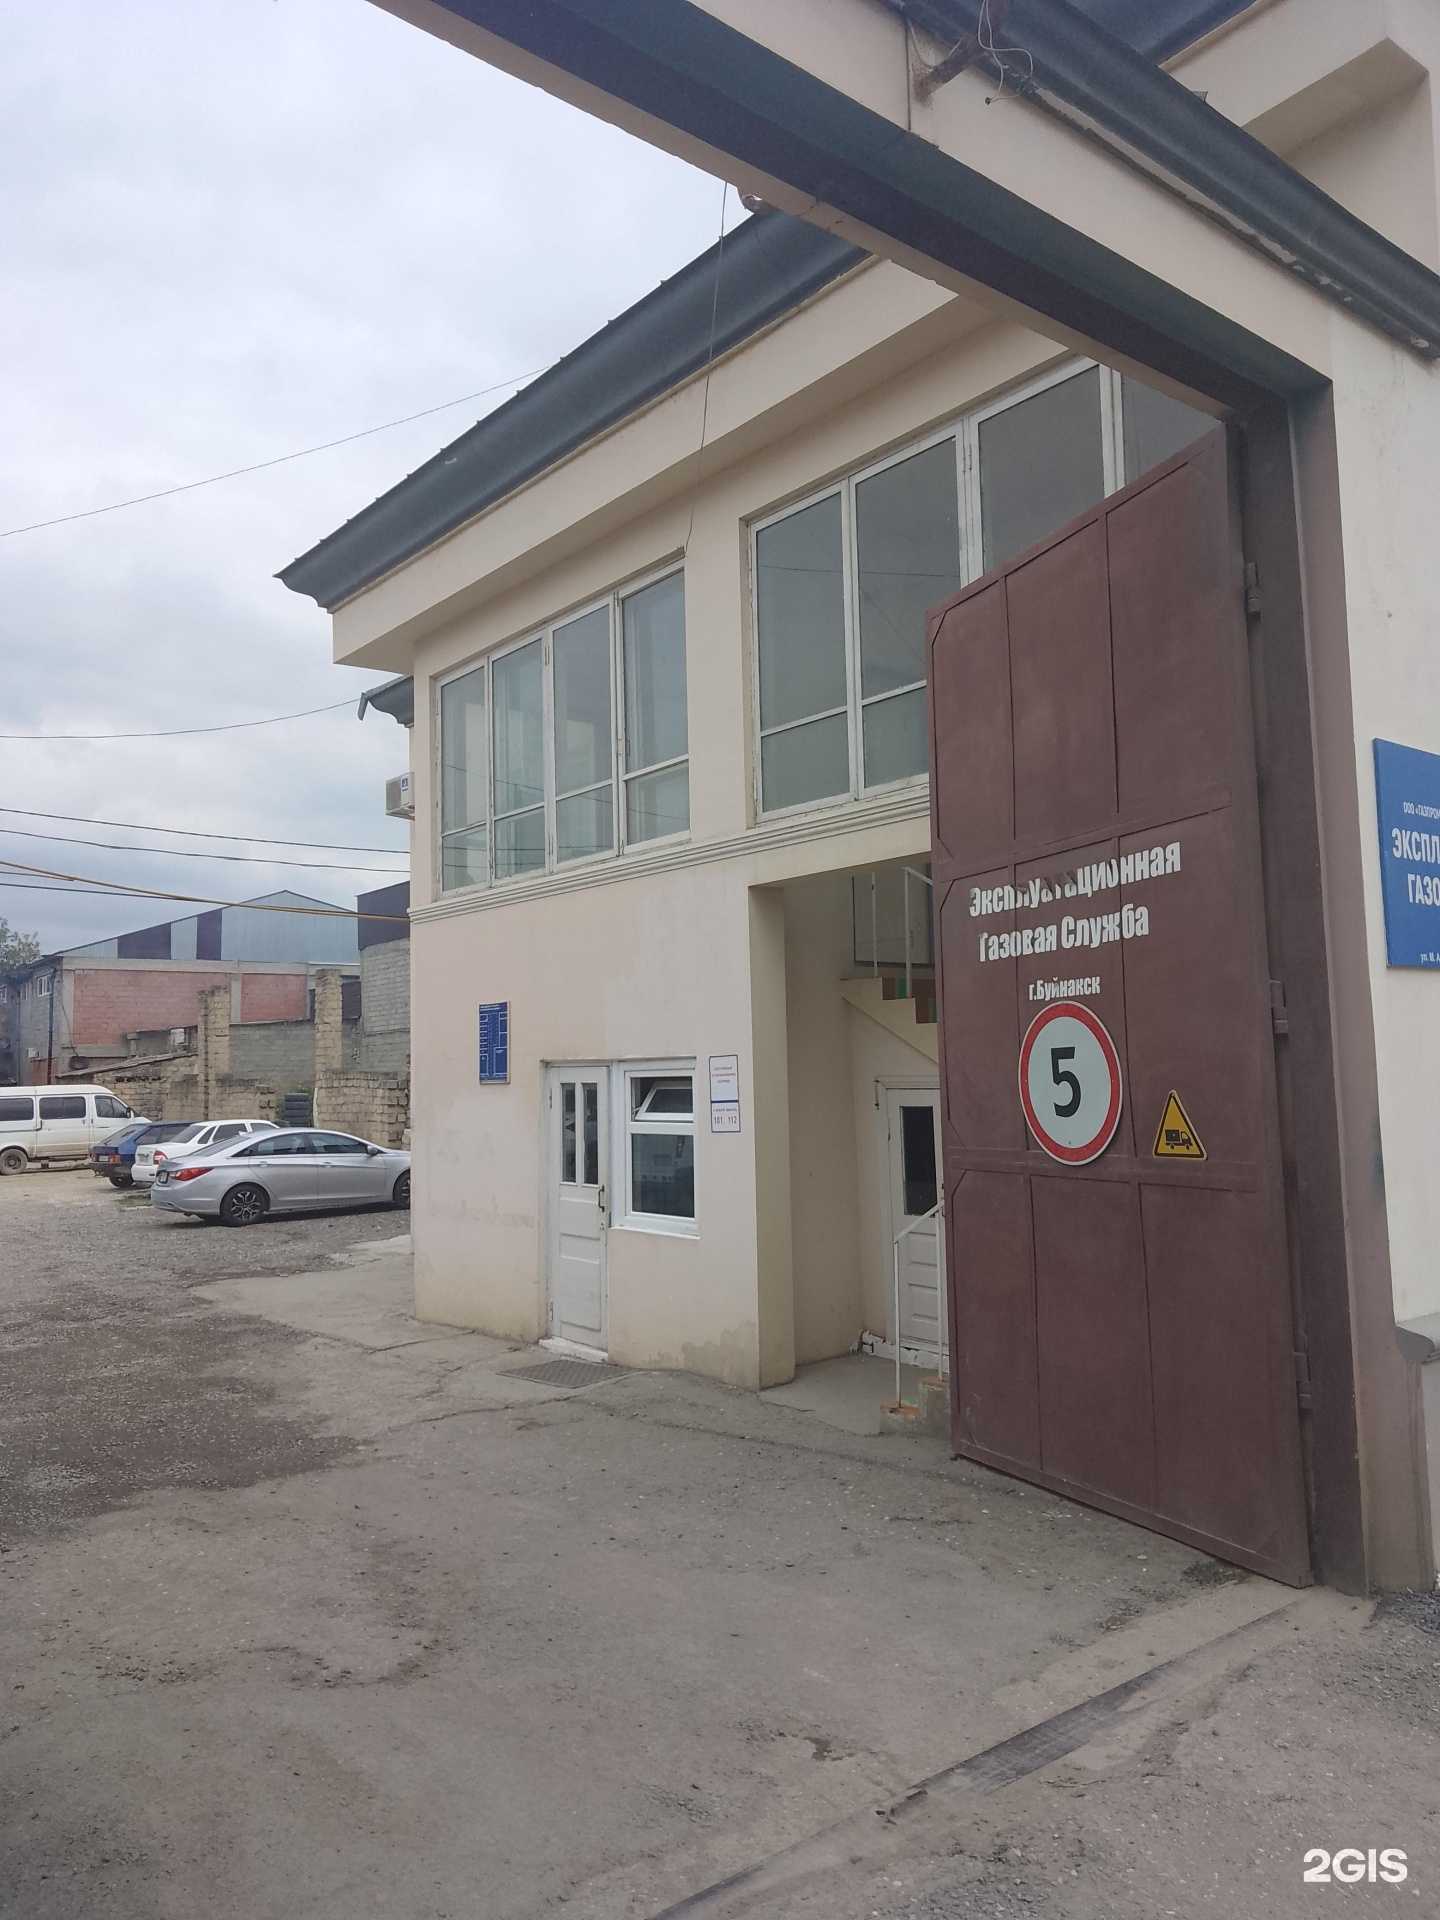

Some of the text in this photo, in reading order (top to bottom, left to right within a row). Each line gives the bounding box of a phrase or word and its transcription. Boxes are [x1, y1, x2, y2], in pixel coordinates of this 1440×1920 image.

[978, 903, 1150, 963] Газовая Служба
[1028, 976, 1101, 1001] г.Буйнакск
[1050, 1046, 1082, 1118] 5
